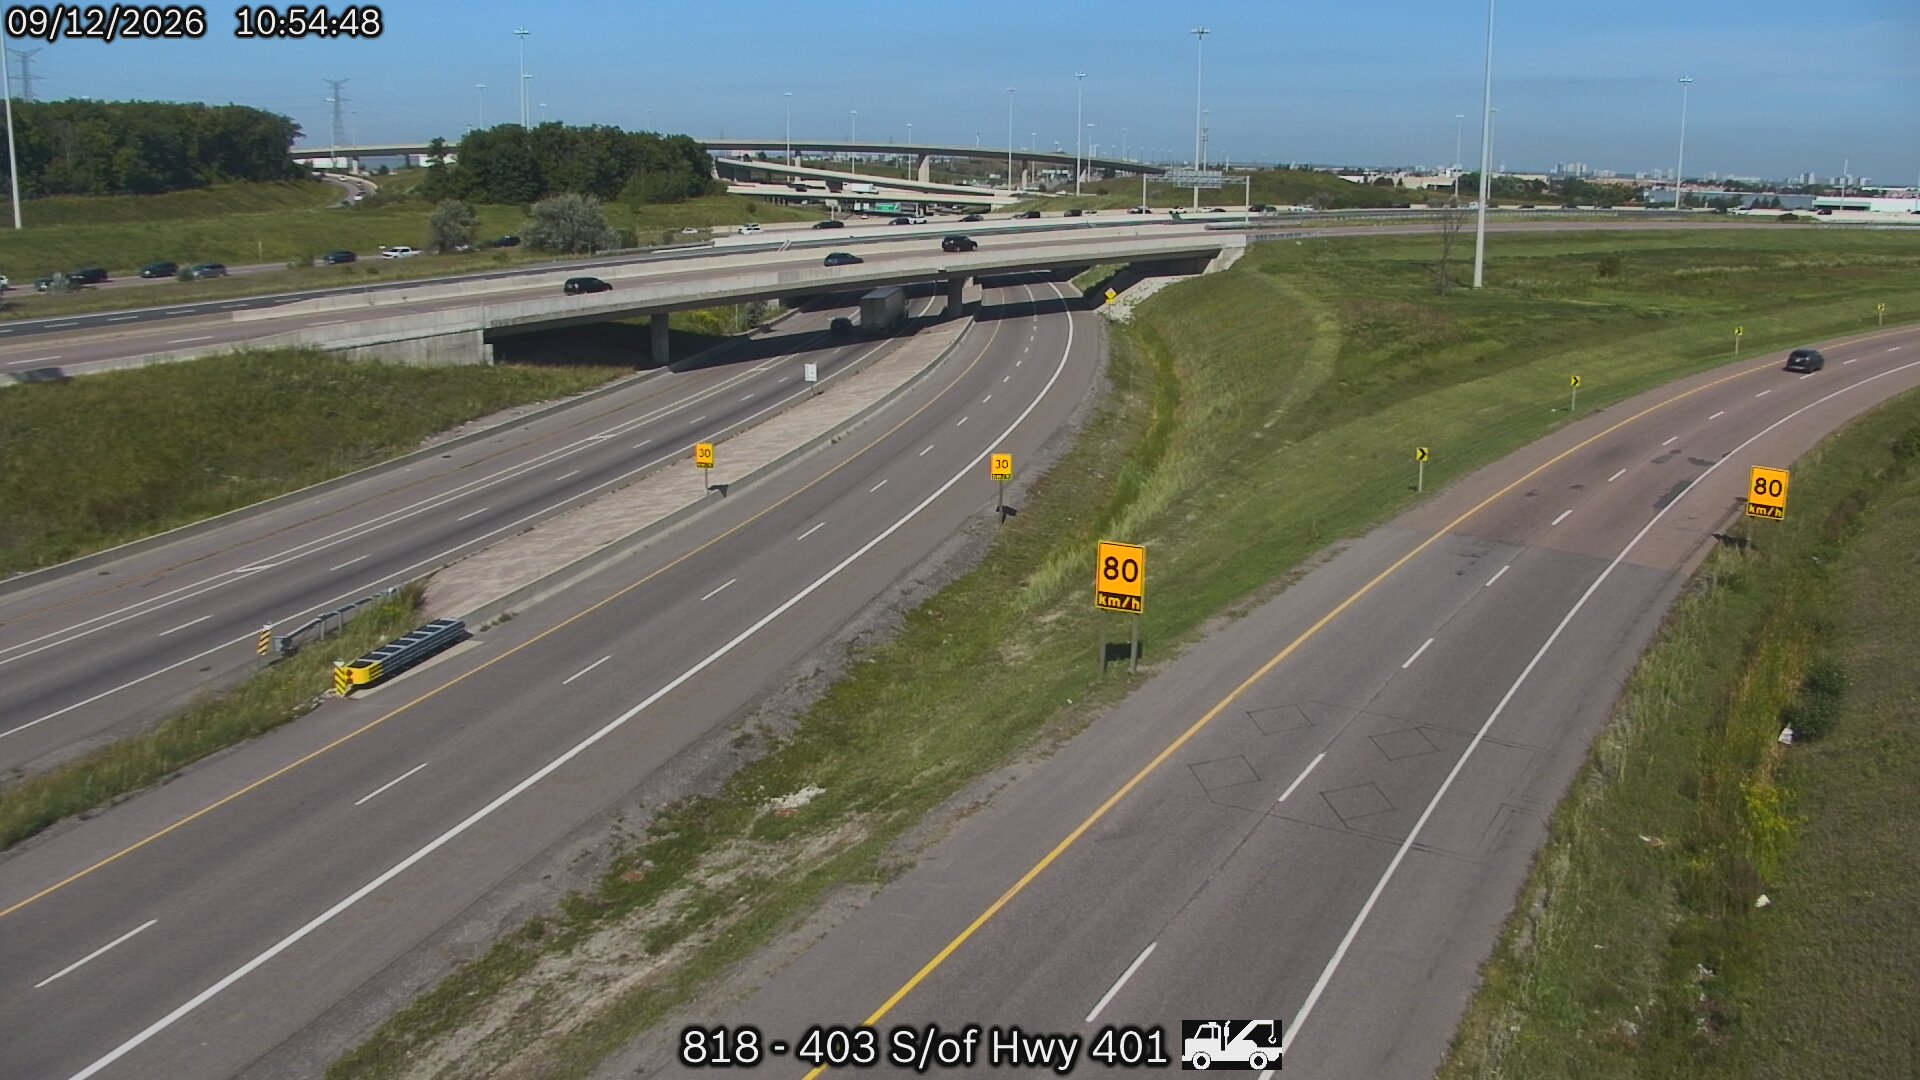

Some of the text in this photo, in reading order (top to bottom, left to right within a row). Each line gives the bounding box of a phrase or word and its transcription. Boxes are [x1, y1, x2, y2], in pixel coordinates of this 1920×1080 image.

[699, 448, 711, 458] 30
[995, 459, 1009, 469] 30
[1754, 477, 1783, 498] 80
[1103, 556, 1139, 583] 80
[1098, 594, 1141, 610] km/h
